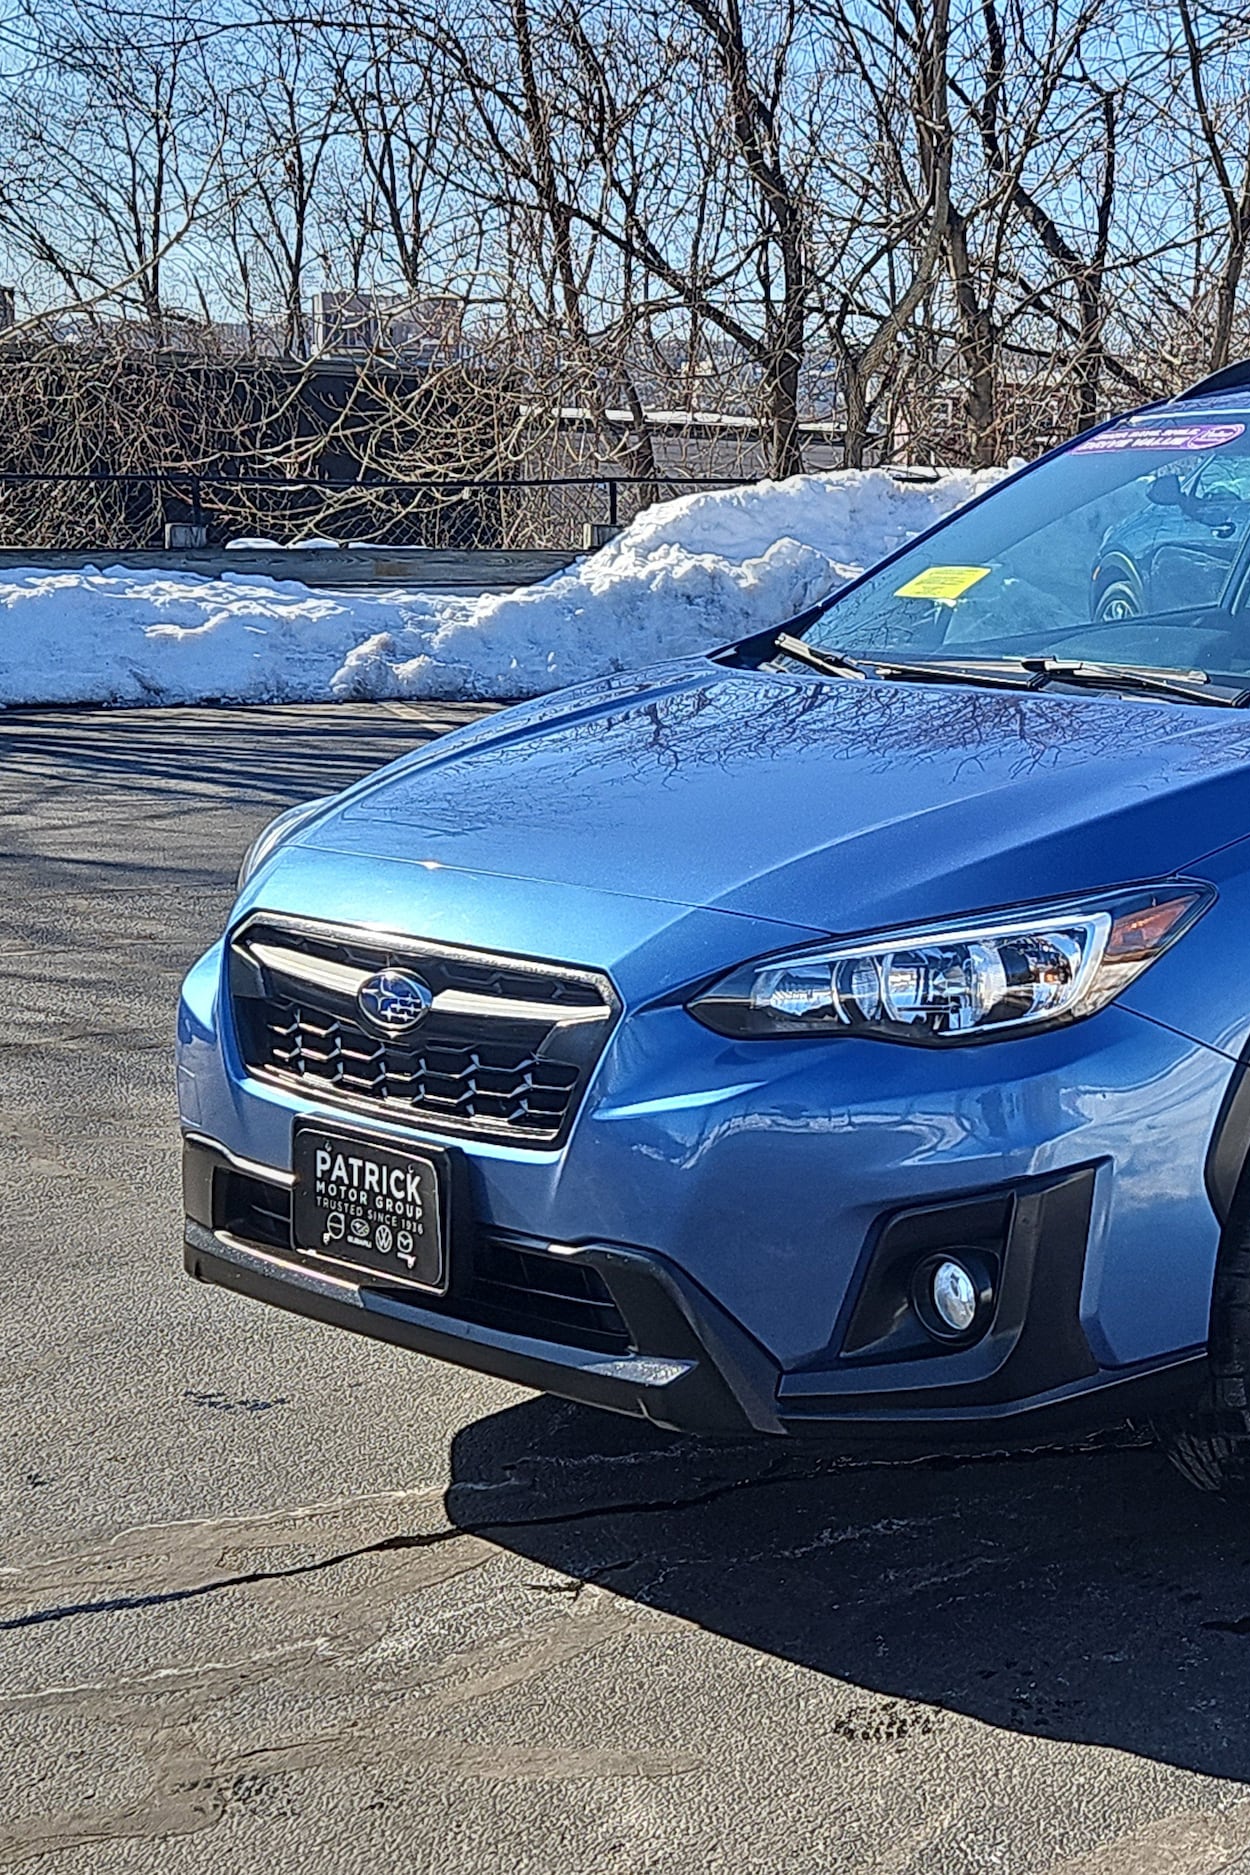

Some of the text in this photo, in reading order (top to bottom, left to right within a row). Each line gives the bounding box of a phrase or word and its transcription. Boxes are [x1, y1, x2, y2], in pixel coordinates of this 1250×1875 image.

[316, 1150, 422, 1206] PATRICK
[316, 1180, 422, 1220] MOTOR GROUP
[316, 1196, 363, 1216] TRUSTED
[367, 1209, 398, 1227] SINCE
